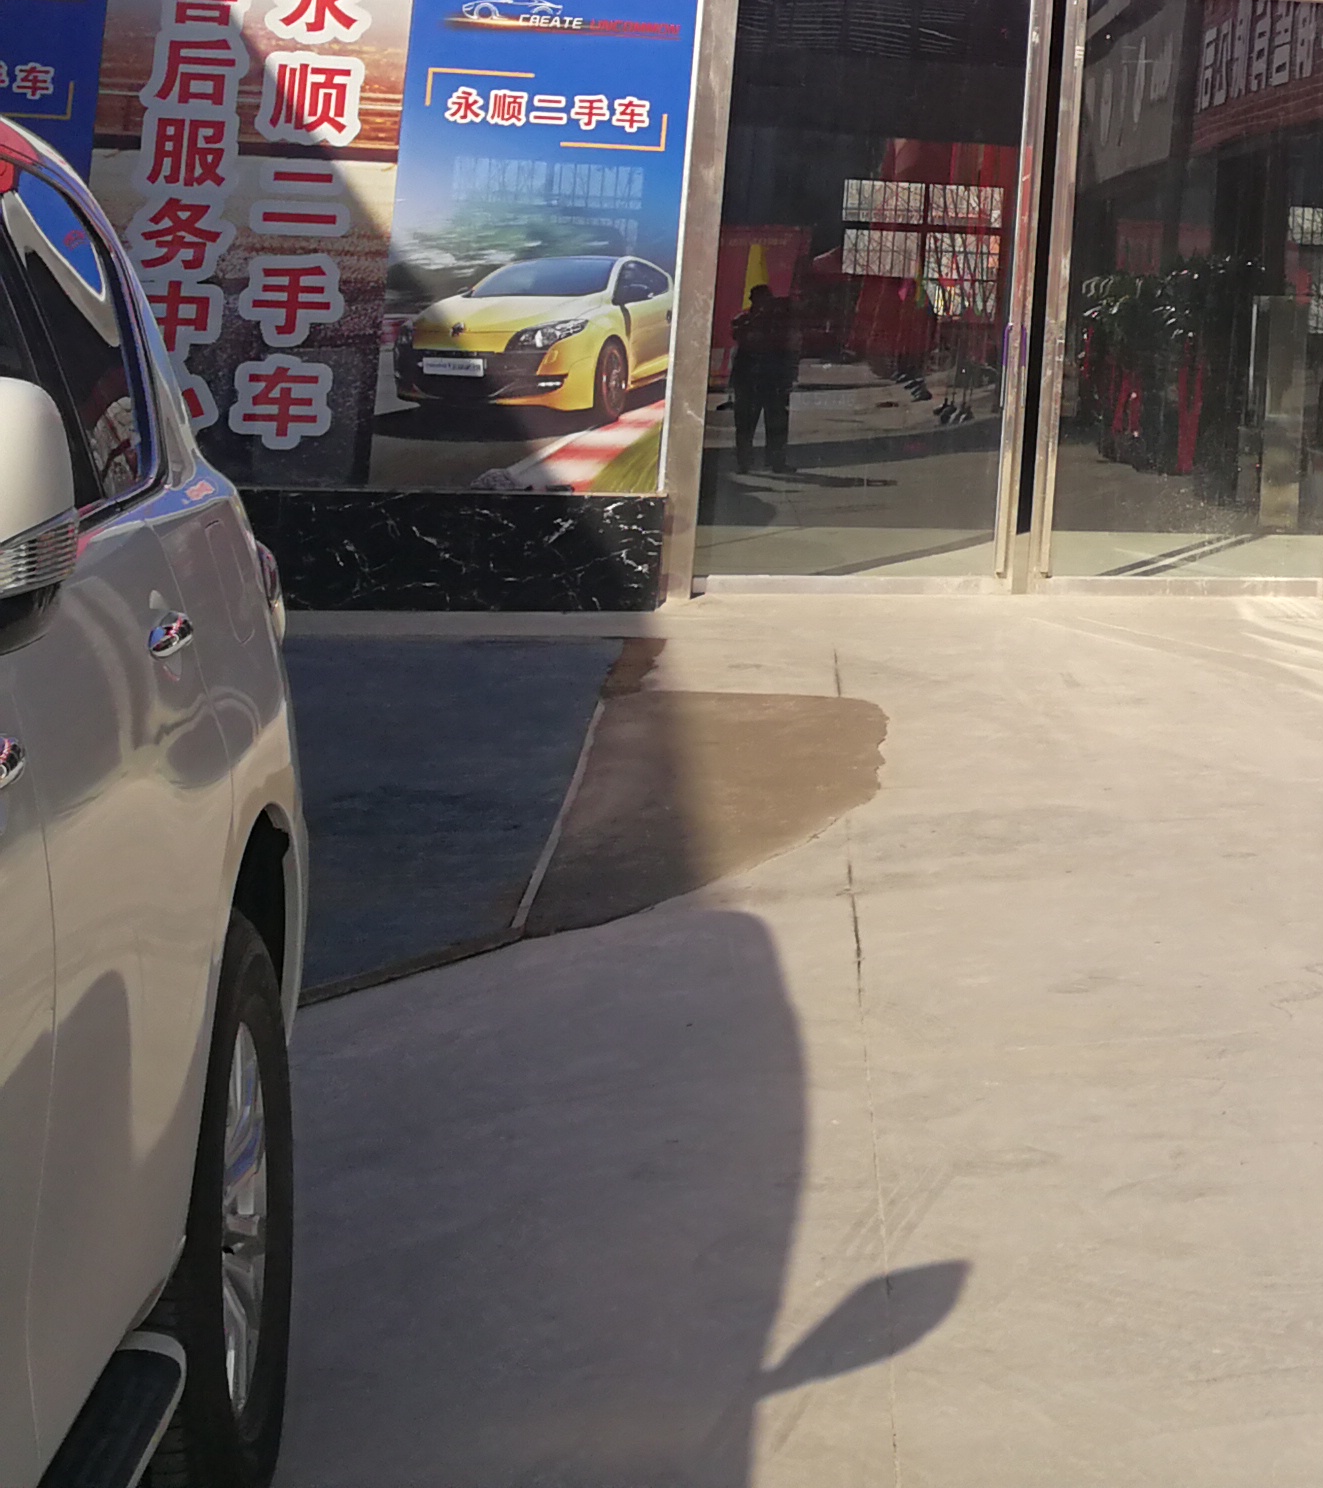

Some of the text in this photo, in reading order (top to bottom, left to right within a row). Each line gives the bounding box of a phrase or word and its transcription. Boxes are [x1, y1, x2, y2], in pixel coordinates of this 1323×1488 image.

[446, 88, 649, 131] 永顺二手车
